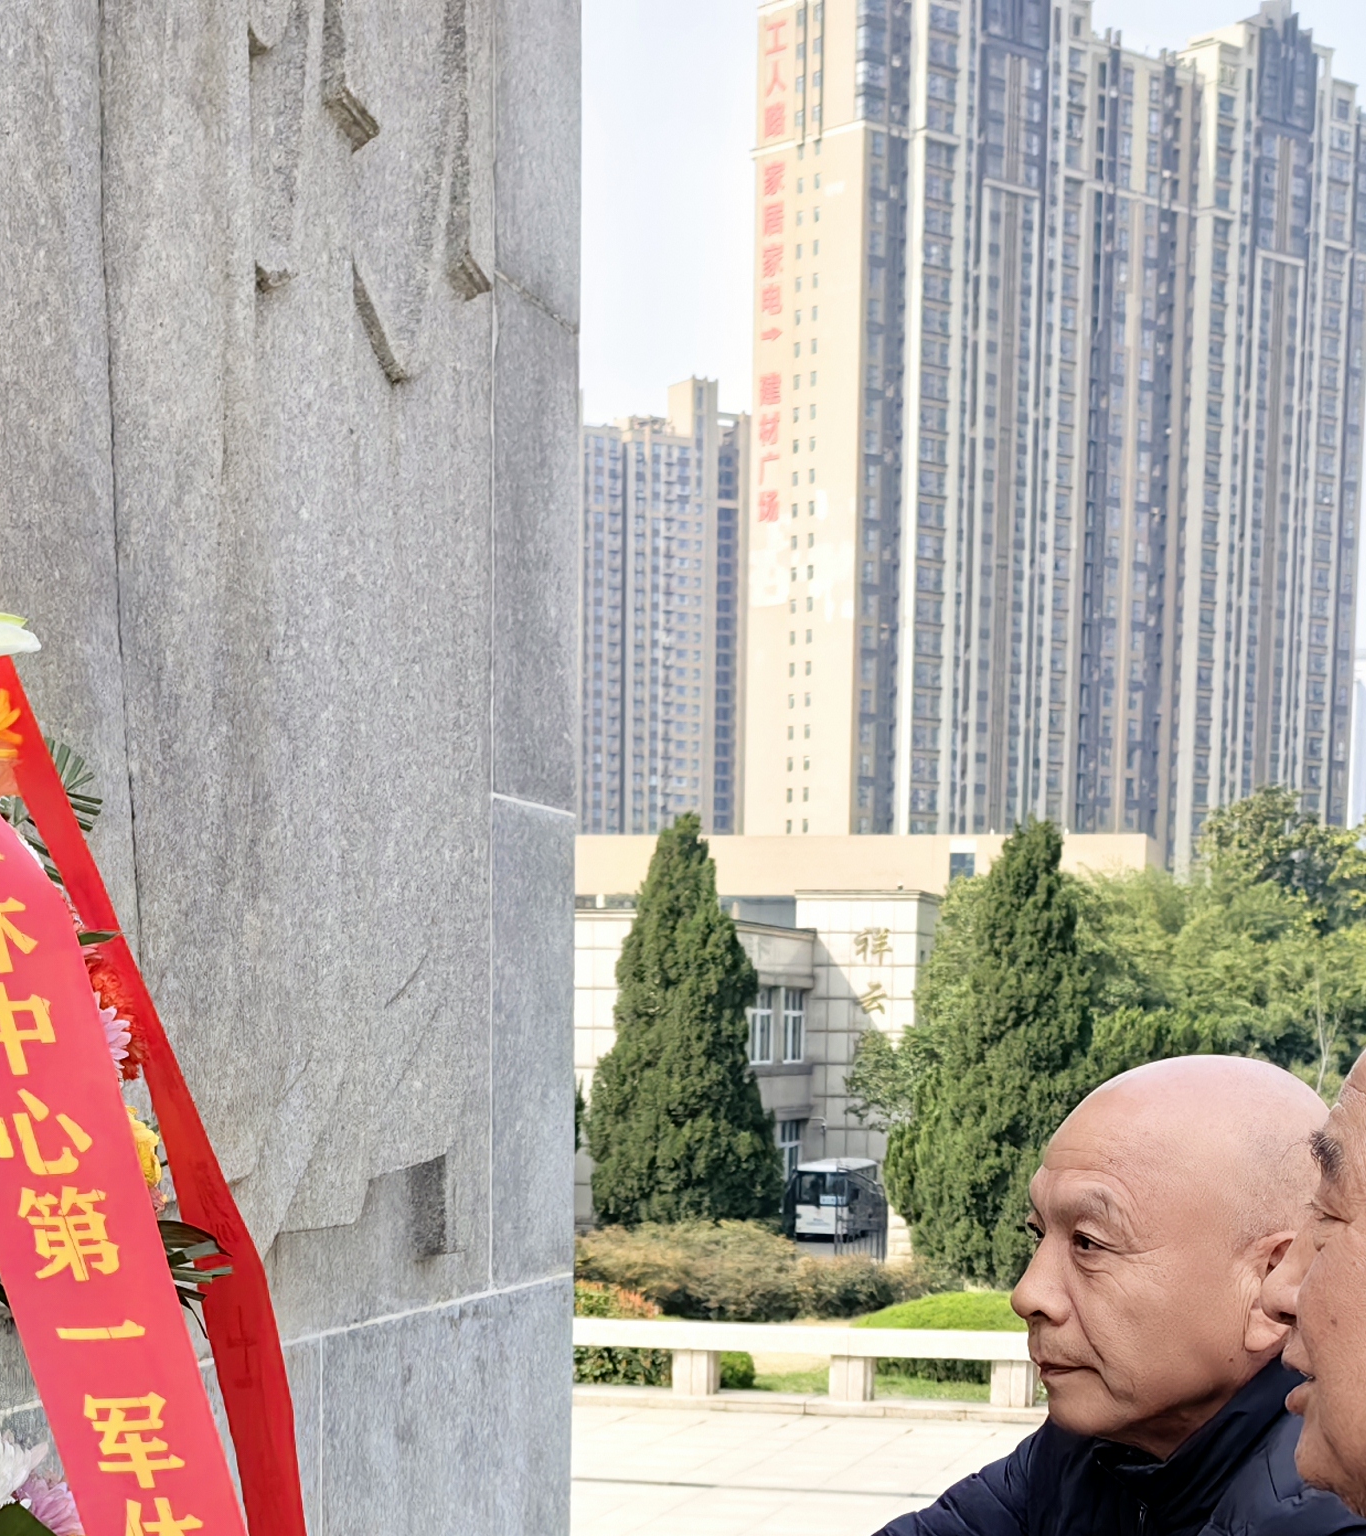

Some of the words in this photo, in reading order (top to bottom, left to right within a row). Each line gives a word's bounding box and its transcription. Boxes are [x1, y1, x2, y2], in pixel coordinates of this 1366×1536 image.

[761, 161, 786, 316] 家居家电
[758, 371, 782, 523] 建材广场
[853, 926, 894, 1015] 祥云
